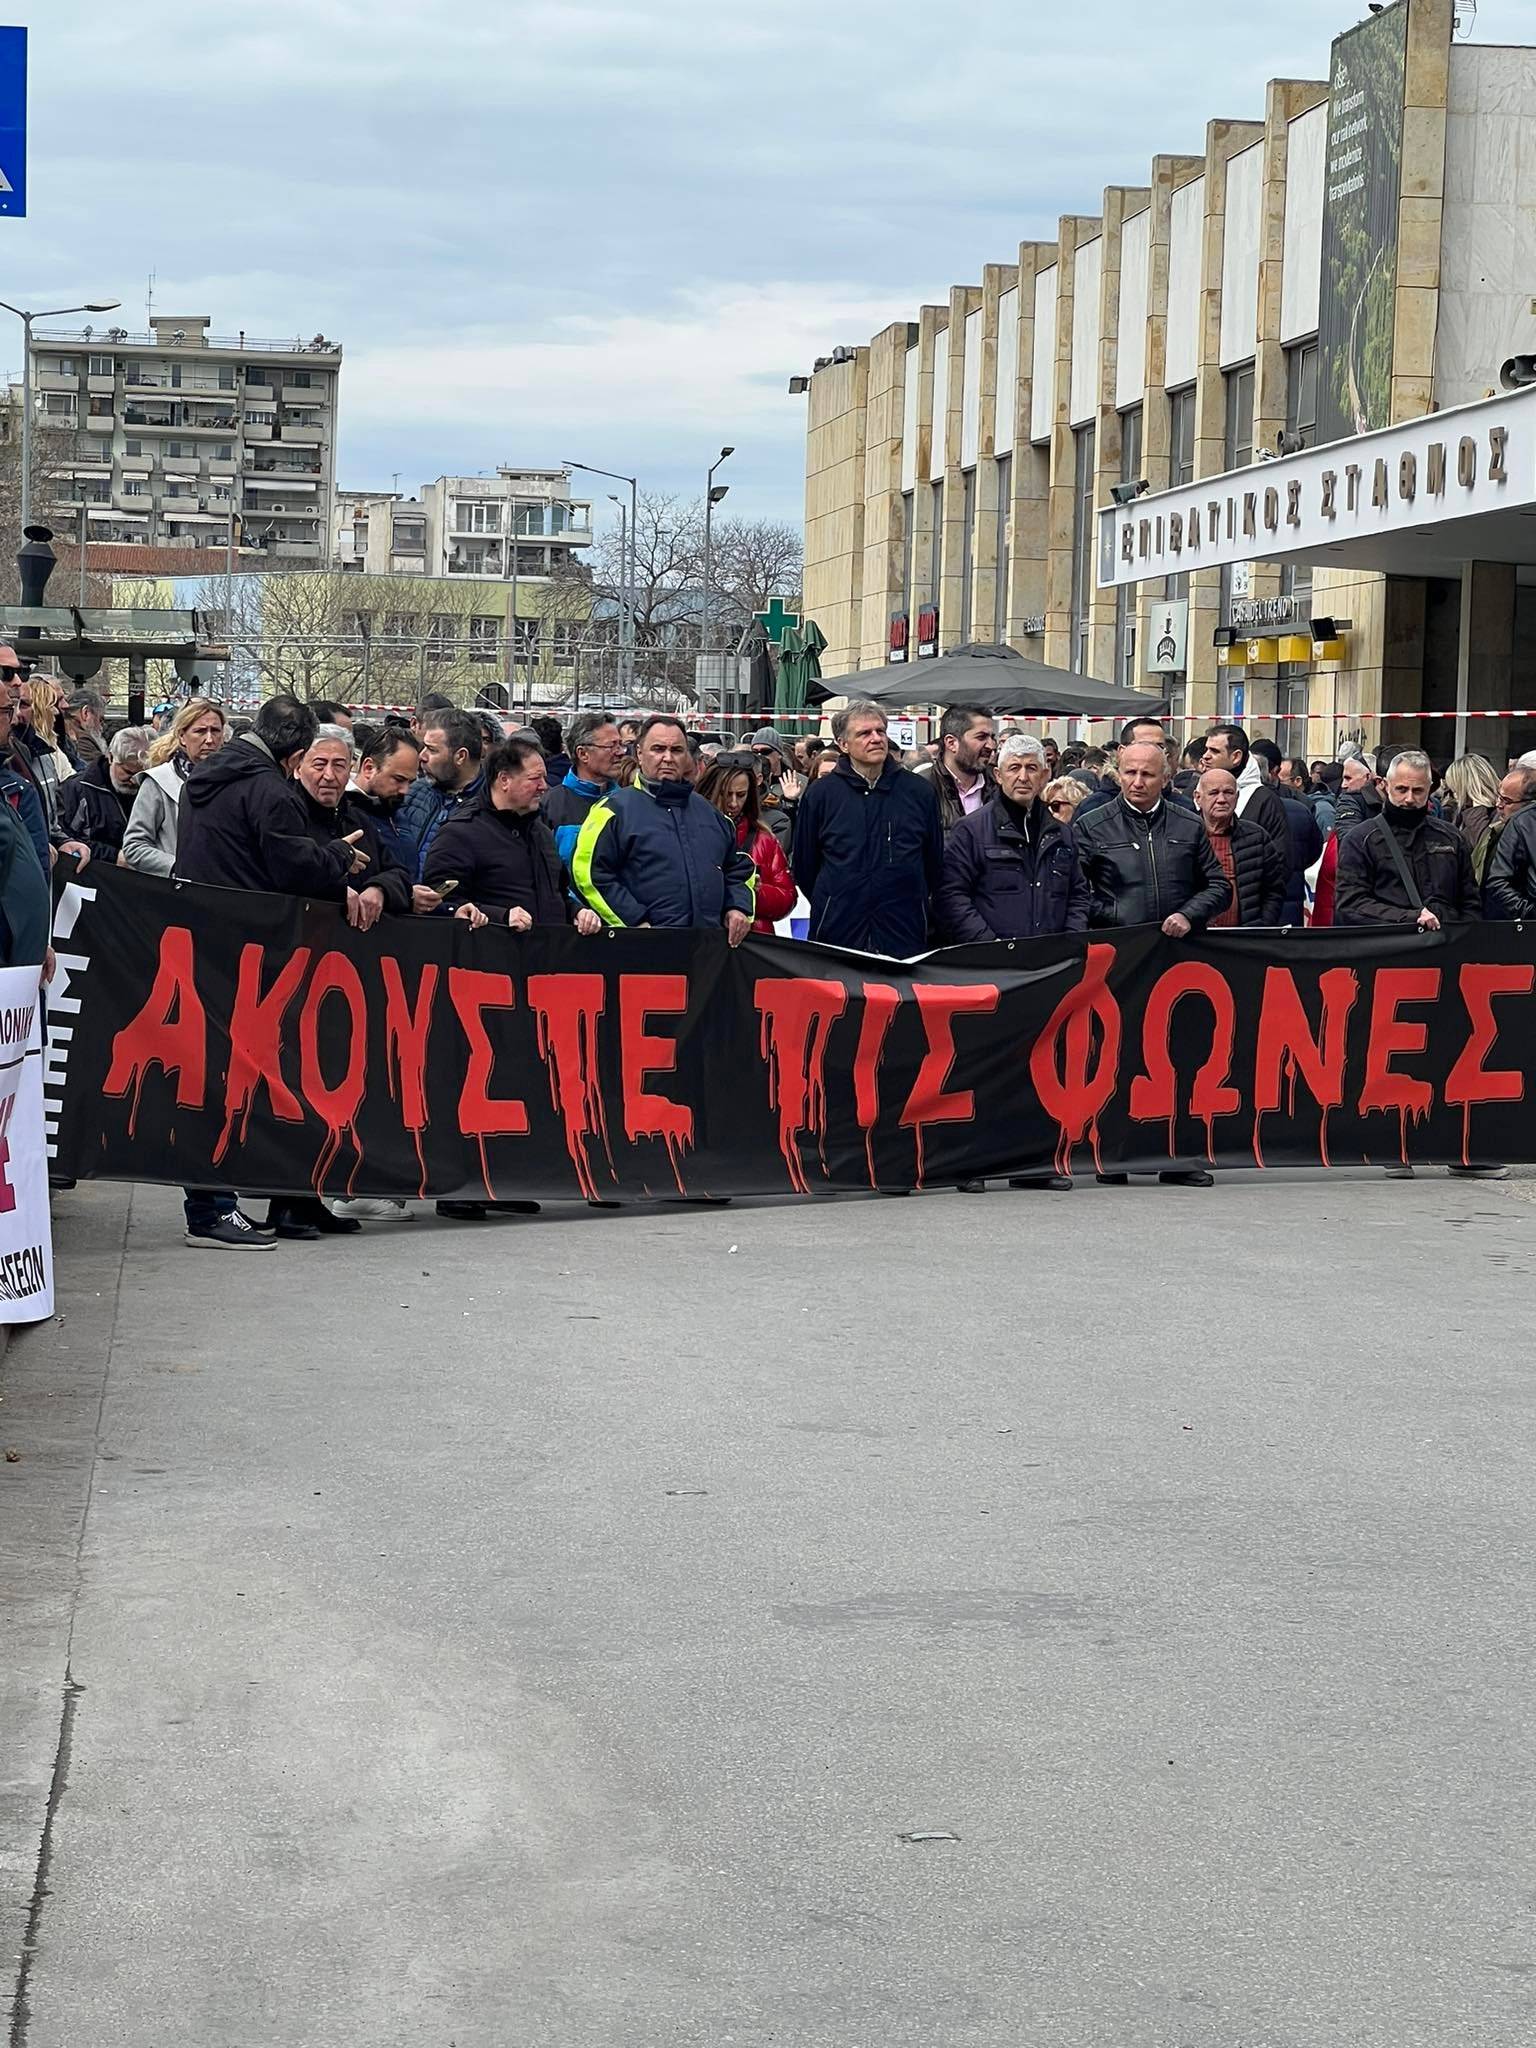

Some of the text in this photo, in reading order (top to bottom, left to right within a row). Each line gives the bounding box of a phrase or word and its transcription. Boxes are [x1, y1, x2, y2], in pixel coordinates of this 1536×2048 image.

[1331, 130, 1340, 147] our
[1341, 89, 1365, 114] transform
[1121, 426, 1508, 563] ΕΠΙΒΑΤΙΚΟΣ ΣΤΑΘΜΟΣ
[102, 926, 695, 1200] ΑΚΟΥΣΤΕ
[754, 977, 1000, 1193] ΤΙΣ
[1030, 943, 1536, 1174] ΦΩΝΕΣ
